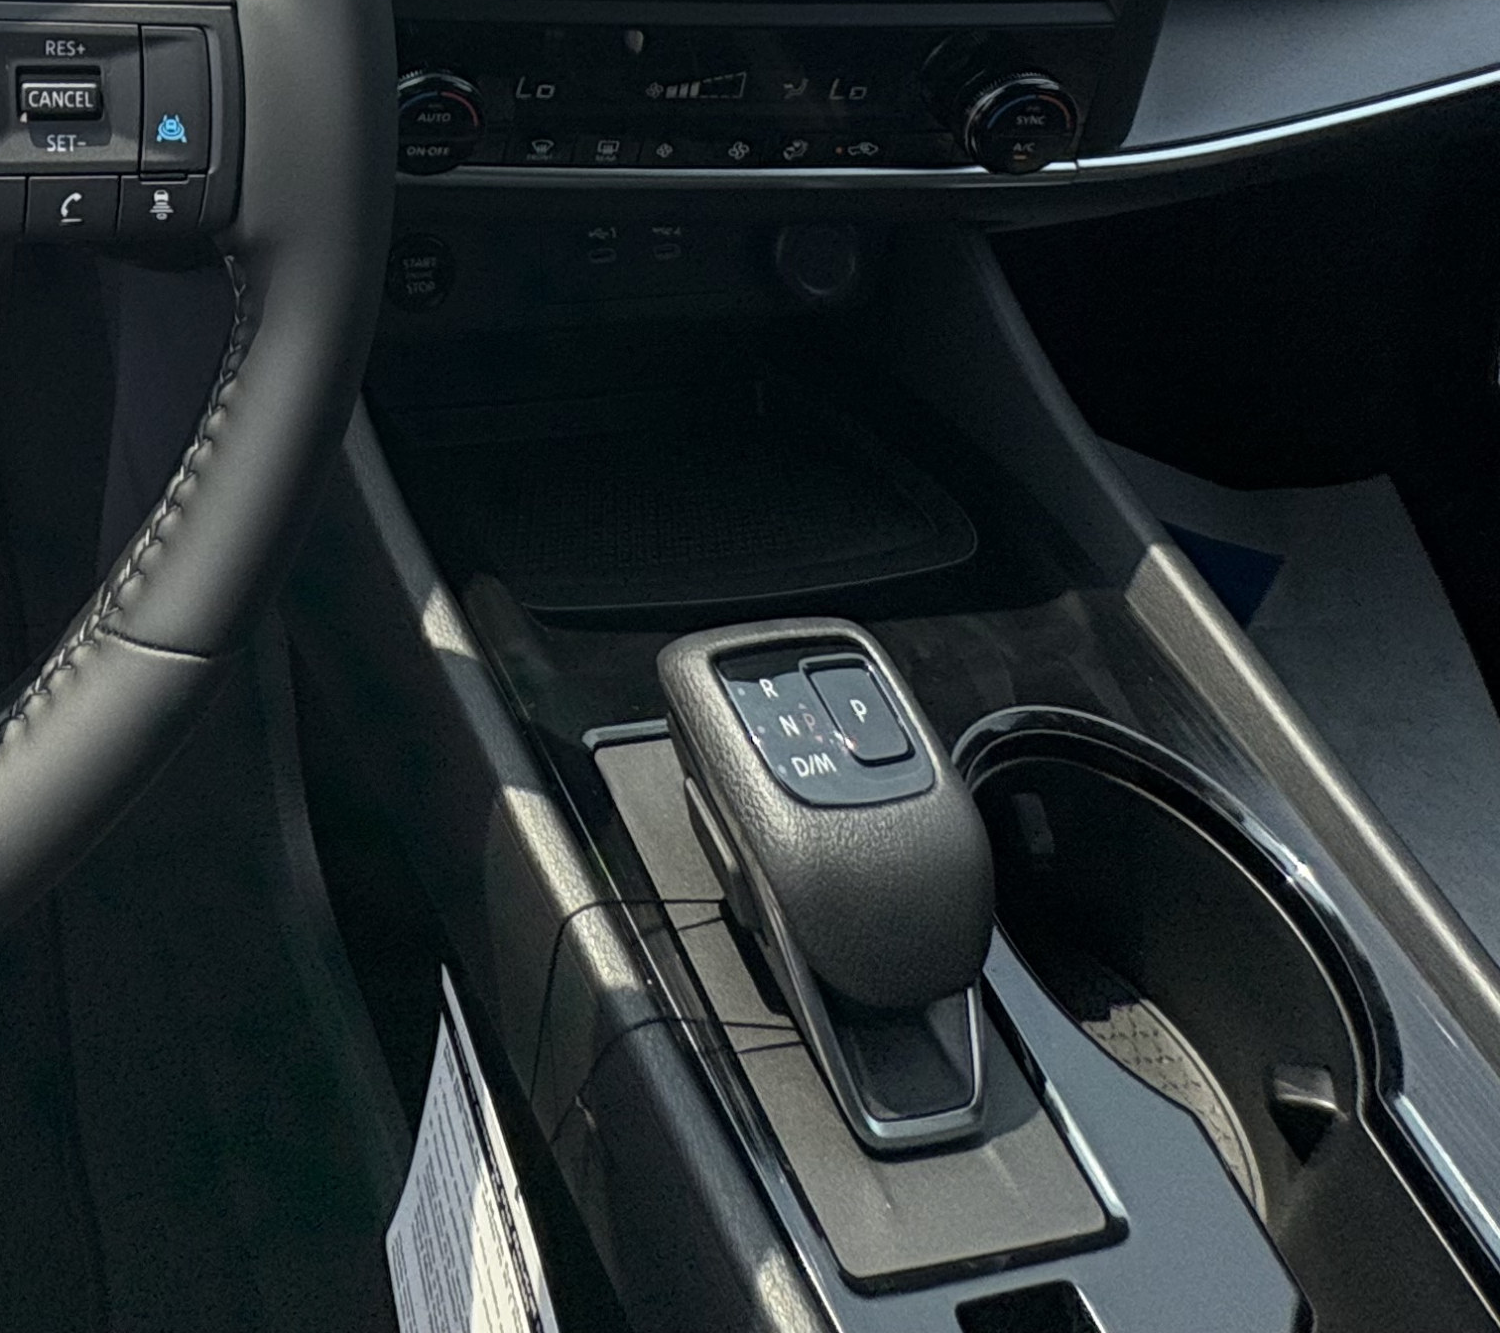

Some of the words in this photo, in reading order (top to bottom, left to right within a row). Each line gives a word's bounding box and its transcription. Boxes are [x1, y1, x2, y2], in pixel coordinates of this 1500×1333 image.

[44, 39, 86, 57] RES+
[515, 75, 556, 100] Lo
[828, 78, 867, 101] Lo
[27, 89, 94, 110] CANCEL
[417, 112, 451, 123] AUTO
[1015, 115, 1046, 126] SYNC
[45, 133, 87, 153] SET-
[1012, 142, 1035, 153] A/C
[759, 678, 779, 698] R
[849, 699, 867, 723] P
[778, 714, 800, 737] N
[791, 752, 837, 778] D/M
